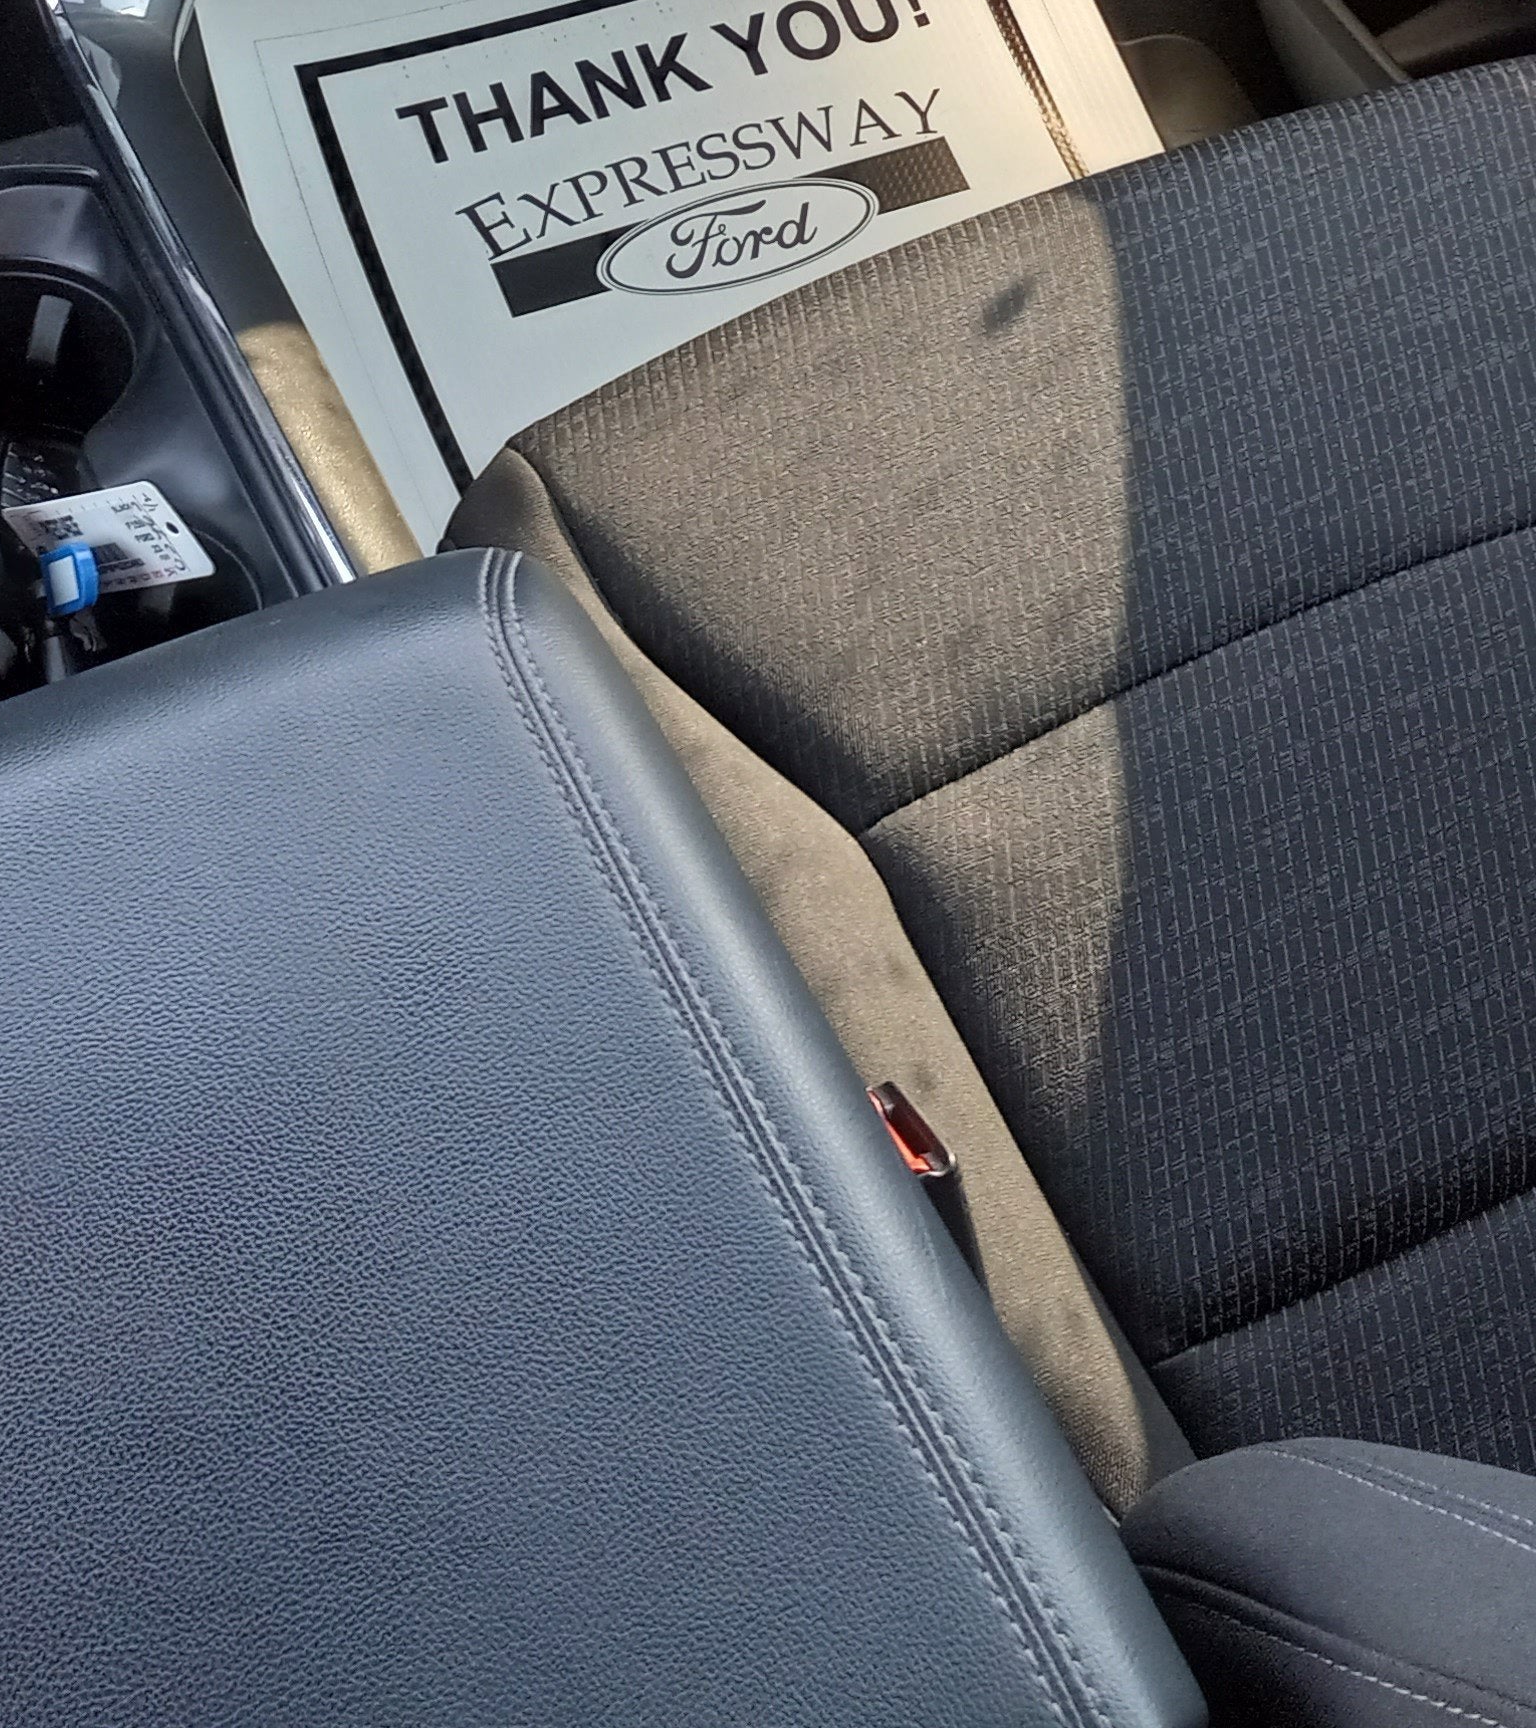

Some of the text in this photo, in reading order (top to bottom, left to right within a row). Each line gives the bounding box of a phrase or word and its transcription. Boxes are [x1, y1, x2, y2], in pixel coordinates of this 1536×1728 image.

[395, 32, 713, 165] THANK
[455, 88, 943, 261] EXPRESSWAY
[664, 198, 819, 280] Ford
